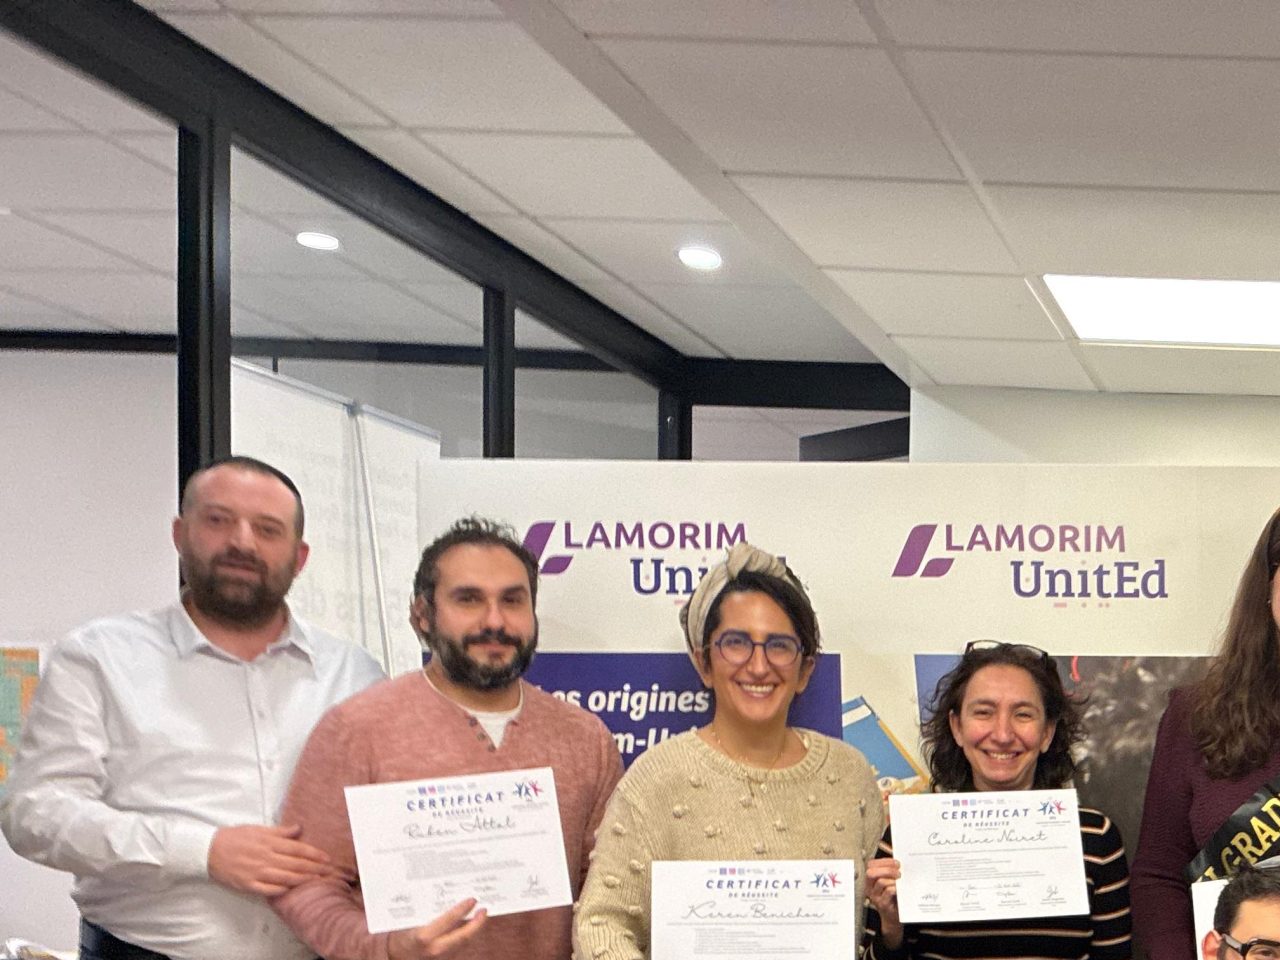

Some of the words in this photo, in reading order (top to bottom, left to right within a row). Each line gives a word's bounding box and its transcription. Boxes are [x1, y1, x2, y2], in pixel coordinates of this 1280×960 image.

[564, 521, 747, 549] LAMORIM
[945, 524, 1125, 552] LAMORIM
[1010, 559, 1168, 598] UnitEd
[588, 683, 711, 721] origines
[407, 791, 504, 811] CERTIFICAT
[941, 808, 1030, 820] CERTIFICAT
[927, 831, 994, 846] Caroline
[706, 879, 802, 889] CERTIFICAT
[681, 900, 748, 919] Keren
